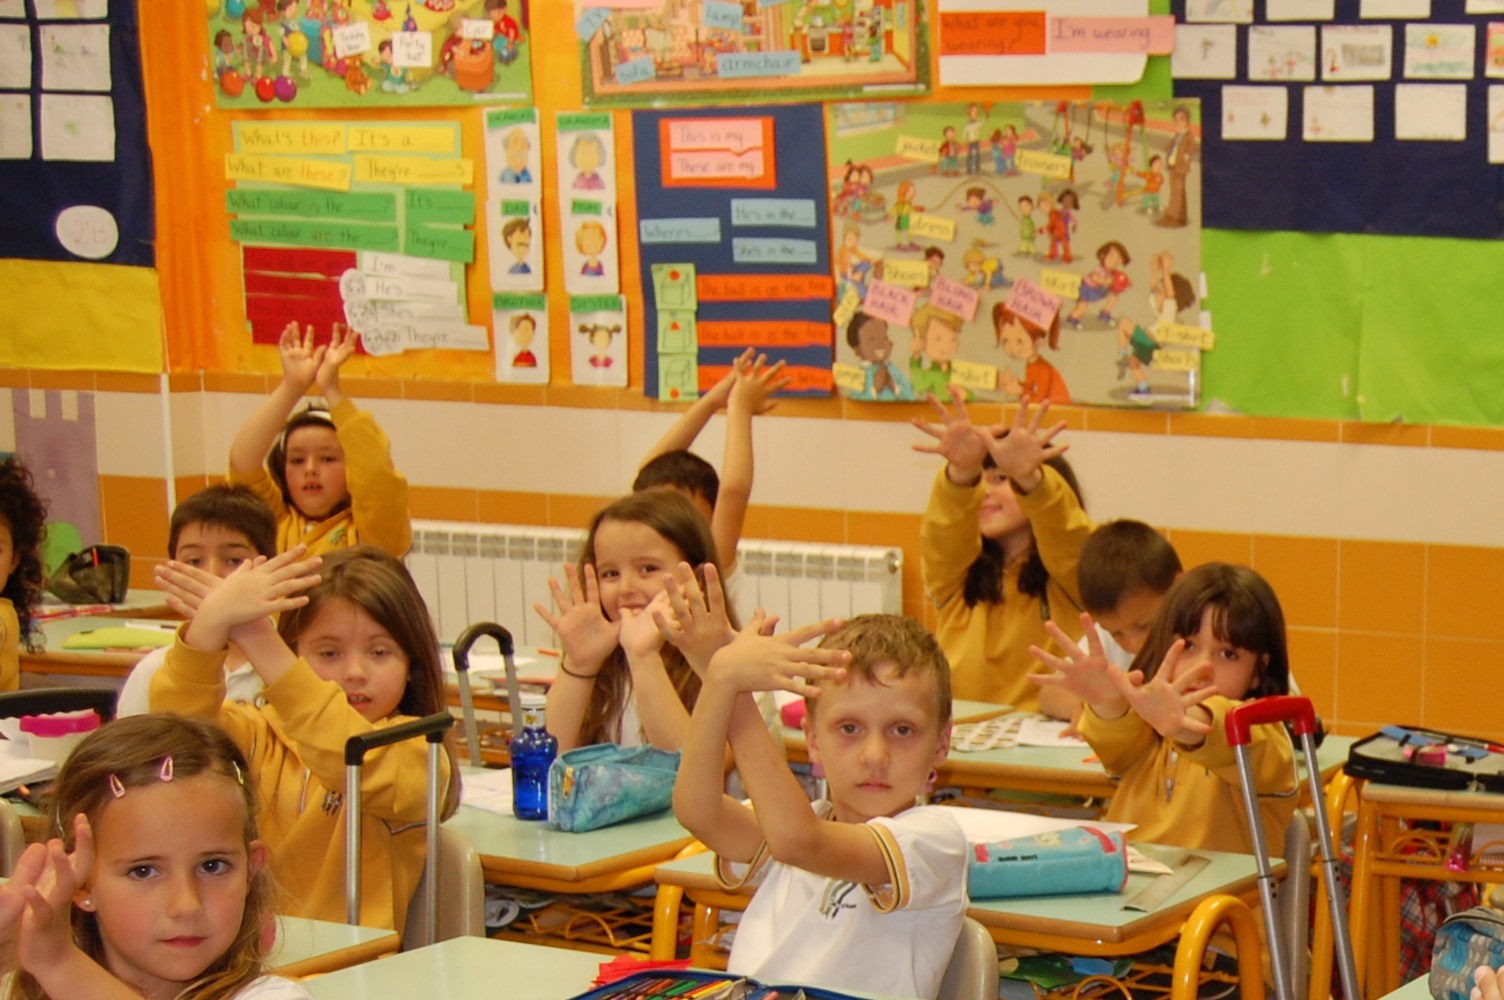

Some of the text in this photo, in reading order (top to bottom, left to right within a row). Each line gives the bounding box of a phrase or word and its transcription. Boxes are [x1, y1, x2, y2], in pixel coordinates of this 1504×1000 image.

[721, 54, 797, 71] armchair
[241, 129, 293, 147] What's
[227, 158, 265, 174] What
